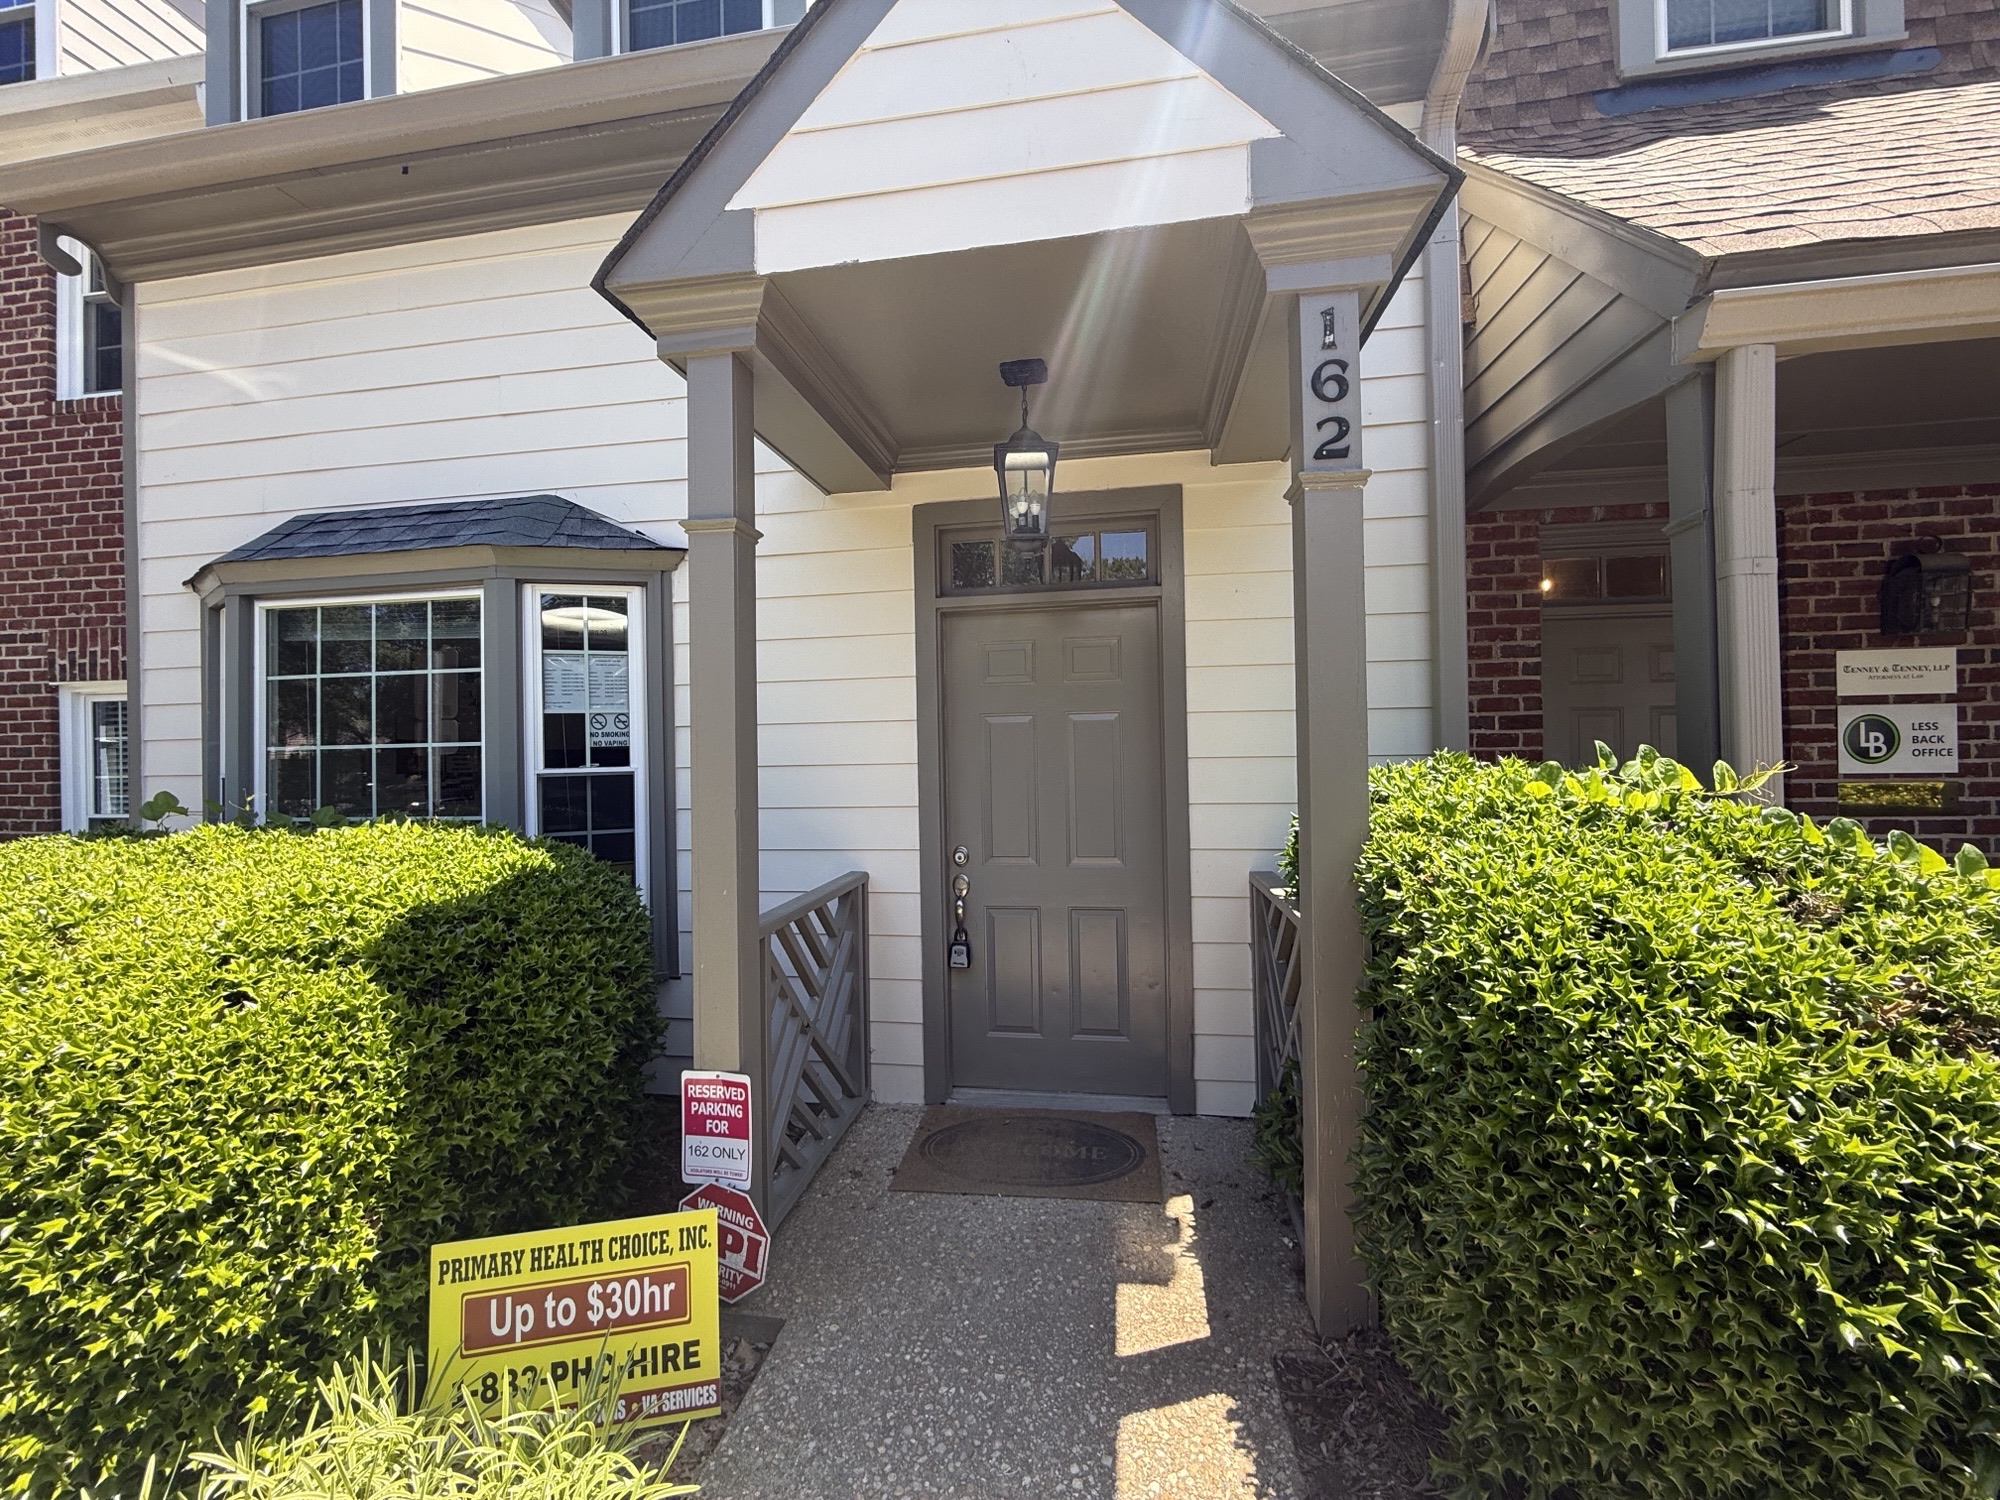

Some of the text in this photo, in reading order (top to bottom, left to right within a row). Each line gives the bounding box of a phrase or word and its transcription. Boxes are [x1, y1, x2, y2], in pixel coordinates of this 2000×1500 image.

[1311, 306, 1351, 460] 162
[1843, 665, 1880, 674] TENNEY
[1933, 664, 1950, 672] LLP
[1911, 722, 1939, 731] LESS
[1911, 734, 1945, 744] BACK
[1911, 748, 1954, 757] OFFICE
[687, 1084, 746, 1101] RESERVED
[691, 1101, 743, 1118] PARKING
[706, 1119, 729, 1134] FOR
[688, 1145, 746, 1160] 162 ONLY
[438, 1224, 712, 1286] PRIMARY HEALTH CHOICE, INC.
[718, 1223, 762, 1274] PI
[490, 1276, 676, 1342] Up to $30hr
[641, 1394, 659, 1414] VA
[662, 1384, 717, 1412] SERVICES
